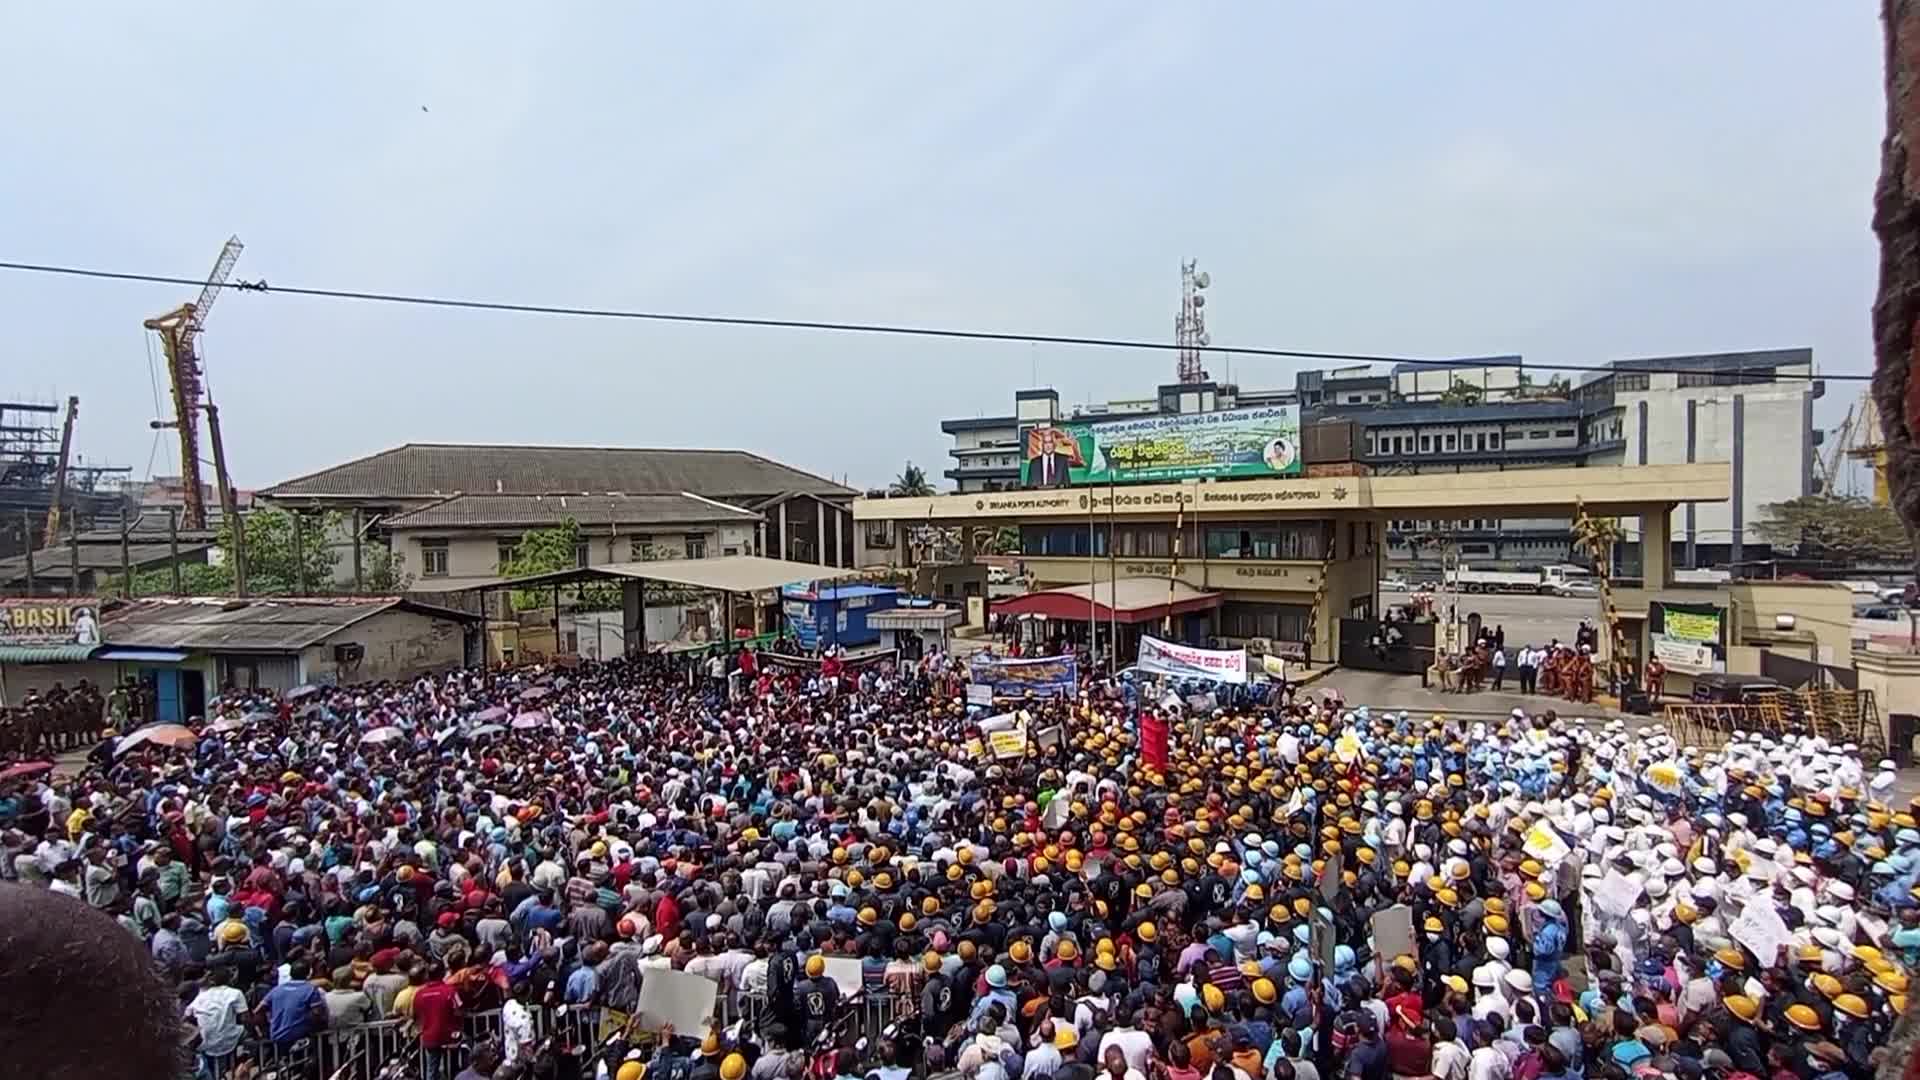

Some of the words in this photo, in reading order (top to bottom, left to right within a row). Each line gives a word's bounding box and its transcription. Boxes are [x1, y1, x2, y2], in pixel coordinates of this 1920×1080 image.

[1000, 501, 1017, 509] LANKA
[1036, 499, 1070, 508] AUTHORITY
[13, 606, 75, 627] BASIL
